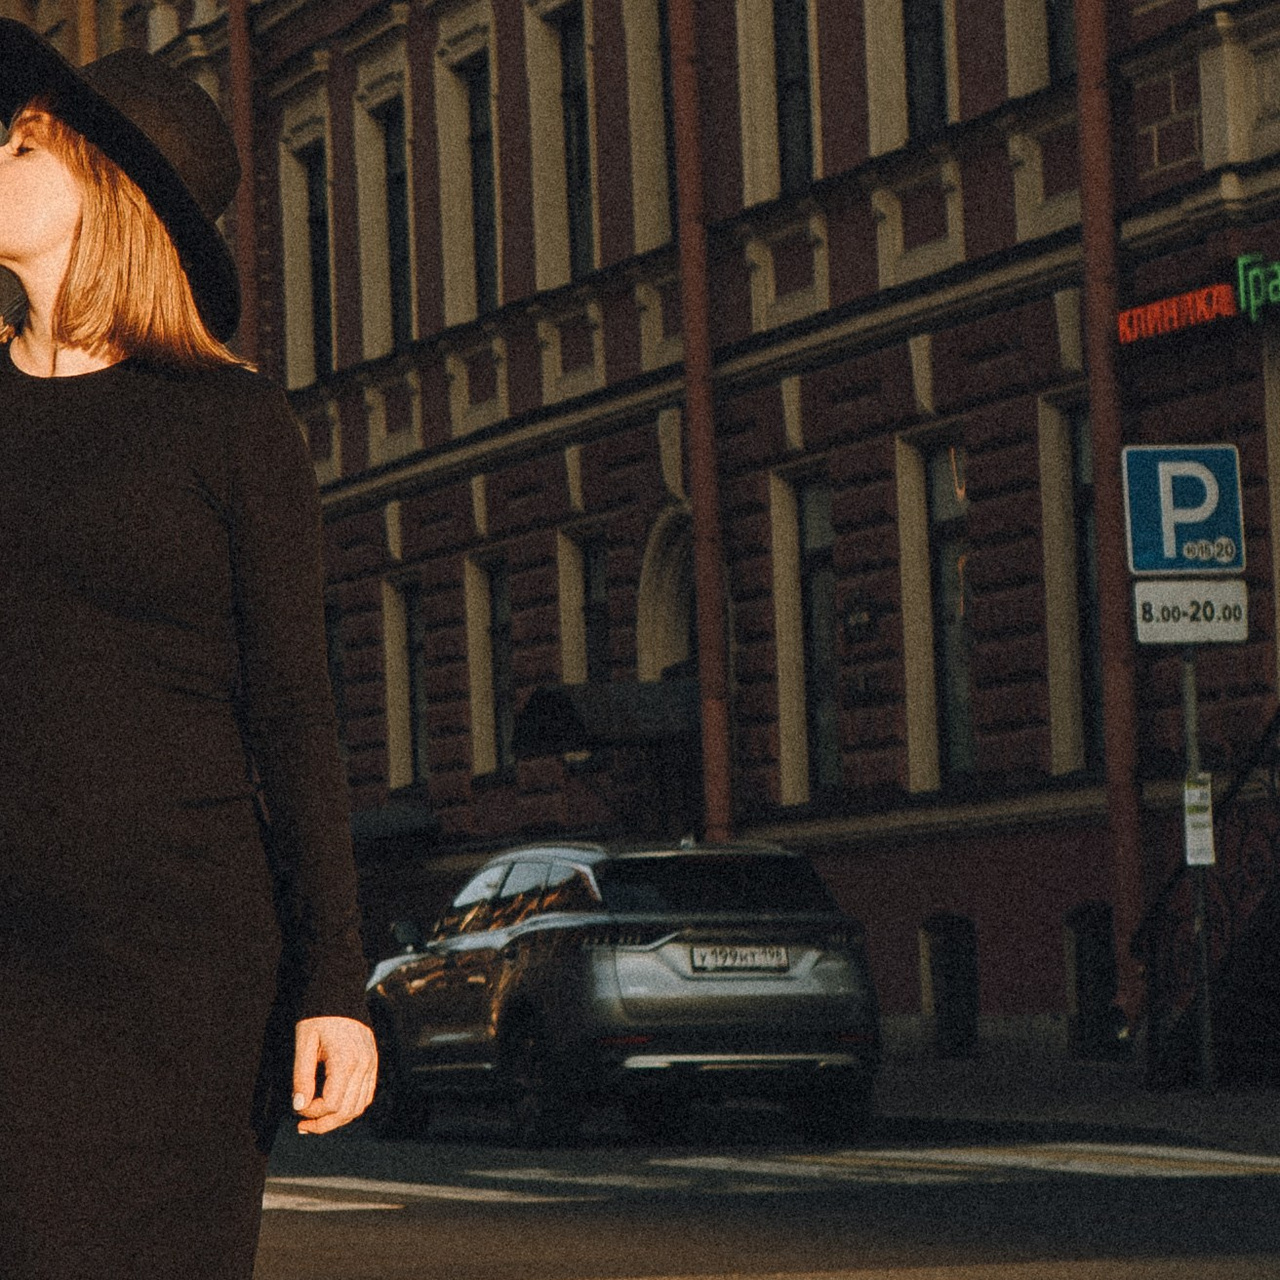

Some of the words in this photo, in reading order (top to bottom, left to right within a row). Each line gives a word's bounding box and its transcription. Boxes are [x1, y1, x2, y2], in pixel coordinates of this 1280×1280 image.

[1118, 283, 1236, 344] КЛИНИКА
[1158, 461, 1219, 558] P
[1216, 541, 1234, 558] 20
